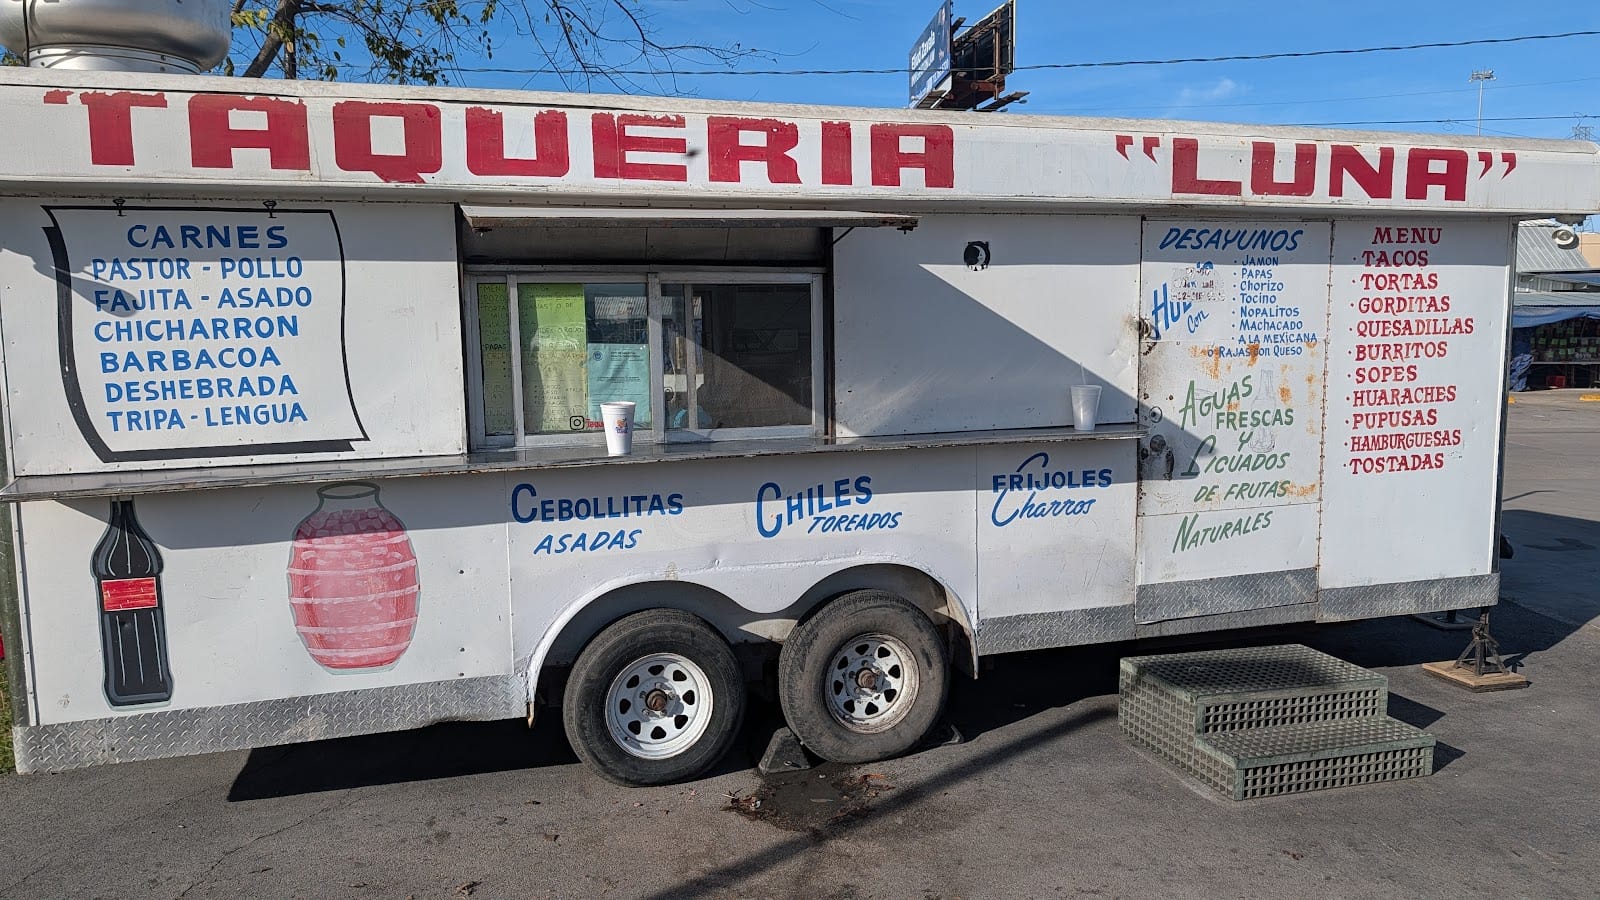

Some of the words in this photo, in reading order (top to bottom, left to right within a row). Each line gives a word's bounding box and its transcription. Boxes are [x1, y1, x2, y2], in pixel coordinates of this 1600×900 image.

[43, 90, 955, 189] TAQUERIA
[127, 224, 289, 250] CARNES
[1159, 227, 1304, 251] DESAYUNOS
[1371, 227, 1443, 245] MENU
[92, 257, 192, 281] PASTOR
[221, 256, 303, 280] POLLO
[1241, 255, 1279, 266] JAMON
[1361, 249, 1429, 268] TACOS
[1241, 268, 1273, 279] PAPAS
[1360, 272, 1439, 293] TORTAS
[94, 288, 192, 313] FAJITA
[217, 286, 313, 308] ASADO
[1358, 295, 1451, 317] GORDITAS
[94, 315, 299, 343] CHICHARRON
[1238, 334, 1246, 344] A
[1249, 333, 1260, 343] LA
[1356, 317, 1474, 338] QUESADILLAS
[100, 346, 282, 374] BARBACOA
[1219, 345, 1250, 358] RAJAS
[1273, 344, 1303, 357] QUESO
[1354, 340, 1448, 363] BURRITOS
[1355, 364, 1418, 384] SOPES
[105, 374, 298, 403] DESHEBRADA
[1352, 385, 1458, 408] HUARACHES
[1179, 374, 1253, 431] AGUAS
[106, 408, 186, 432] TRIPA
[205, 402, 308, 427] LENGUA
[1216, 408, 1294, 431] FRESCAS
[1351, 408, 1438, 430] PUPUSAS
[1350, 429, 1462, 453] HAMBURGUESAS
[1349, 452, 1445, 475] TOSTADAS
[991, 452, 1097, 528] Charros
[992, 467, 1113, 493] FRIJOLES
[1193, 484, 1220, 503] DE
[1223, 480, 1291, 501] FRUTAS
[511, 483, 684, 524] CEBOLLITAS
[756, 475, 873, 539] CHILES
[807, 511, 903, 535] TOREADOS
[1172, 510, 1274, 554] NATURALES
[533, 528, 643, 555] ASADAS
